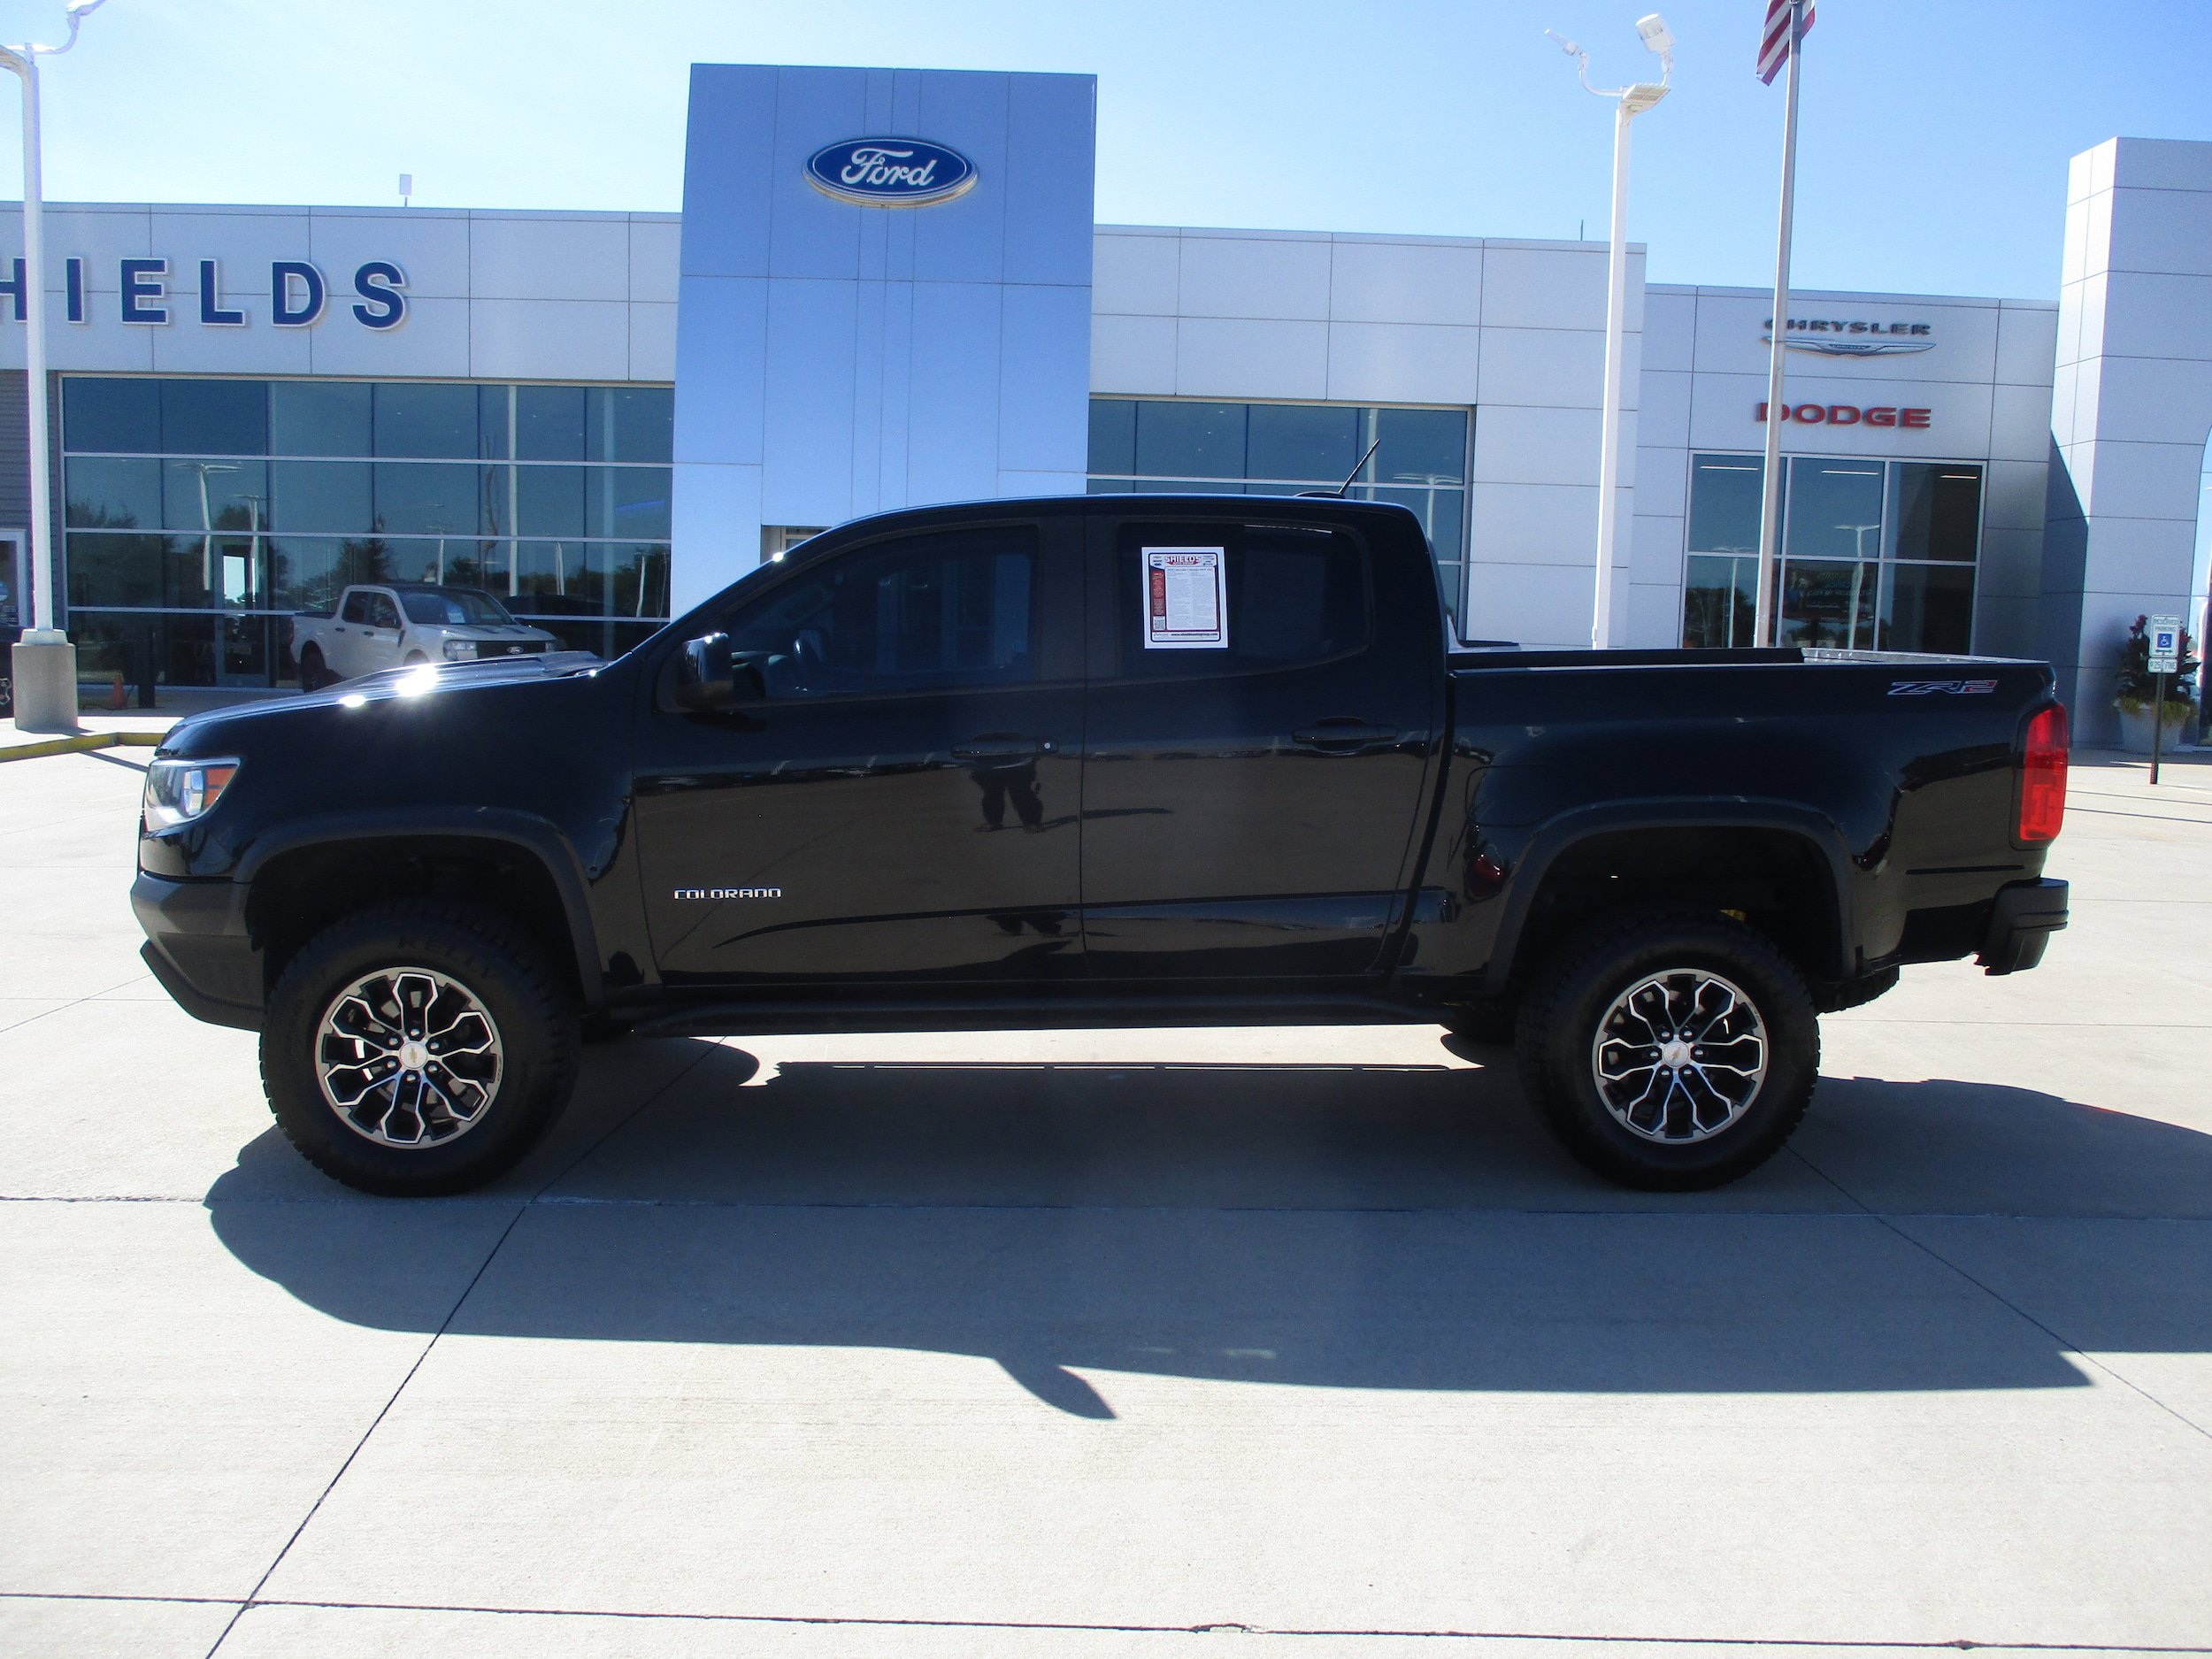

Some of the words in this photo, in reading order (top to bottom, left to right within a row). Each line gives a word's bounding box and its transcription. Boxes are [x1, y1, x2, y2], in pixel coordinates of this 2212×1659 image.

[841, 147, 937, 187] Ford
[1886, 680, 1999, 695] ZR2
[673, 887, 782, 900] COLORADO
